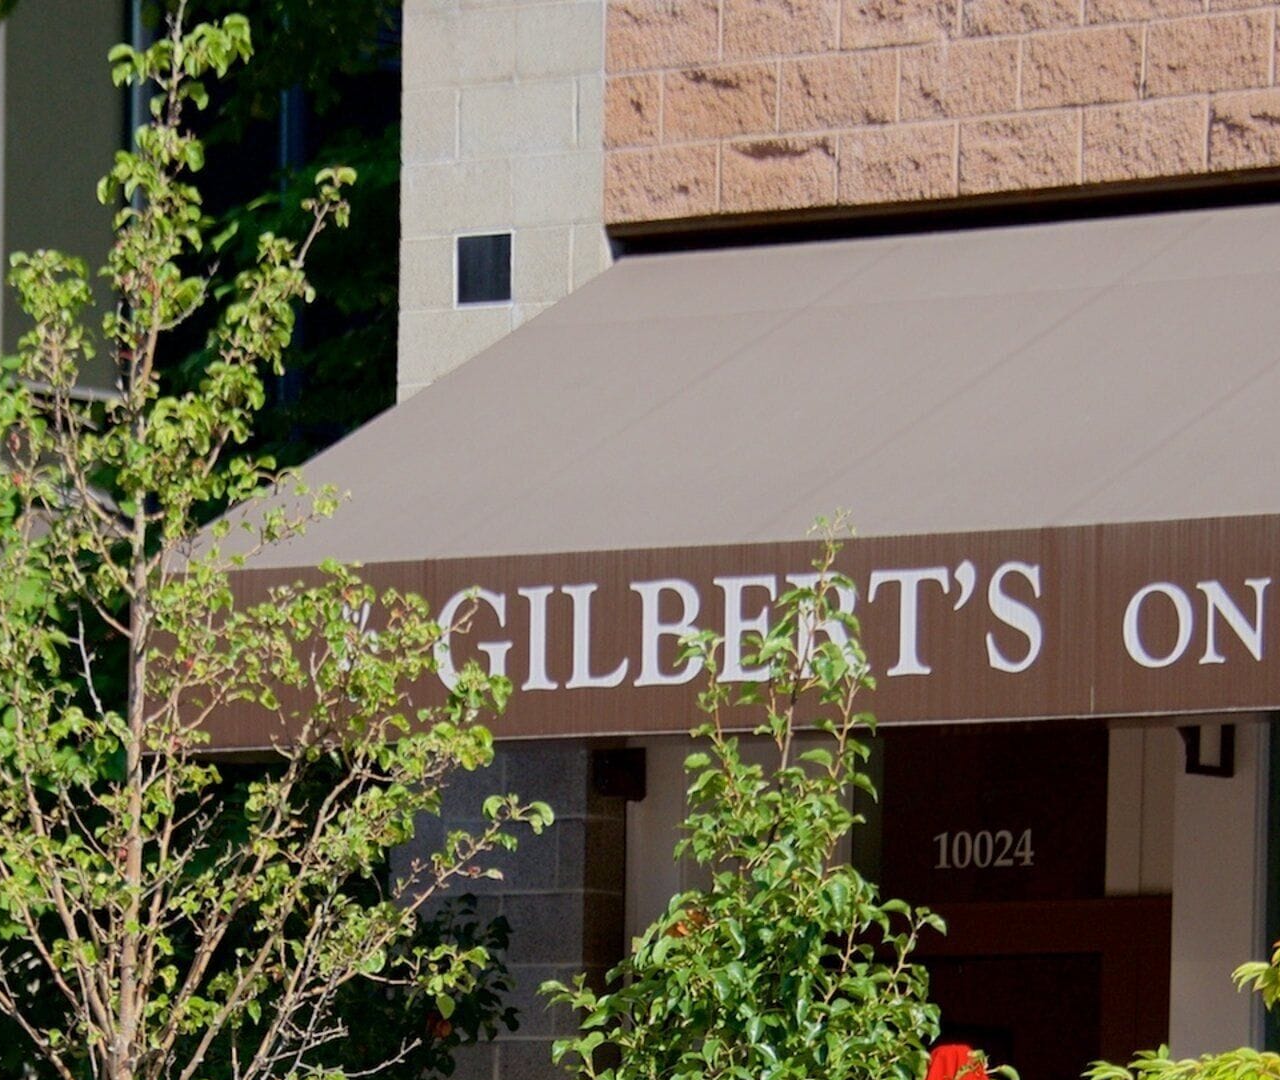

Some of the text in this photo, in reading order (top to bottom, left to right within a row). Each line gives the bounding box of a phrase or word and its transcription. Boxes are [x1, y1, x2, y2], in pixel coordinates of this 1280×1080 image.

[433, 560, 1044, 692] GILBERT'S
[1122, 577, 1272, 669] ON
[932, 828, 1035, 870] 10024
